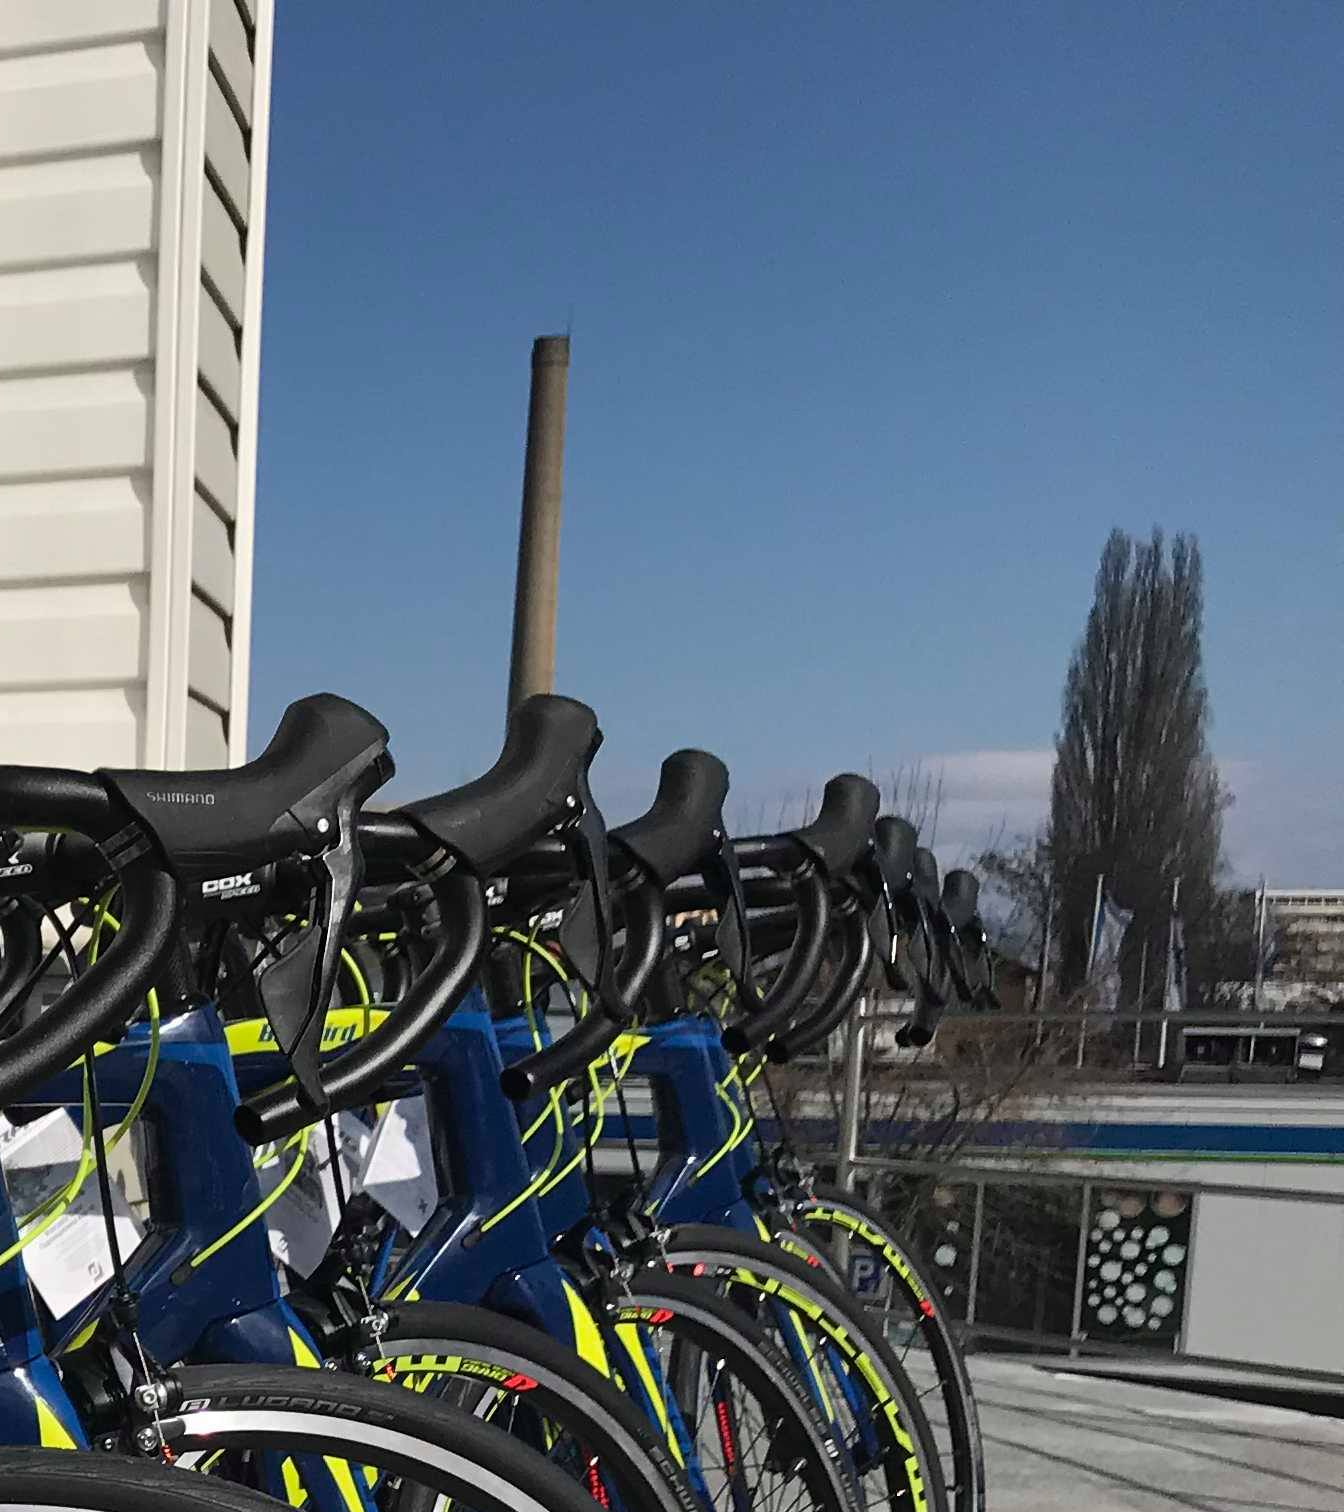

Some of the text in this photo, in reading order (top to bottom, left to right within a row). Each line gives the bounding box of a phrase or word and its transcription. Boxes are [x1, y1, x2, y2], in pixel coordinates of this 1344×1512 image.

[145, 790, 217, 807] SHIMANO
[201, 872, 254, 894] COX
[217, 1396, 364, 1418] LUGANO
